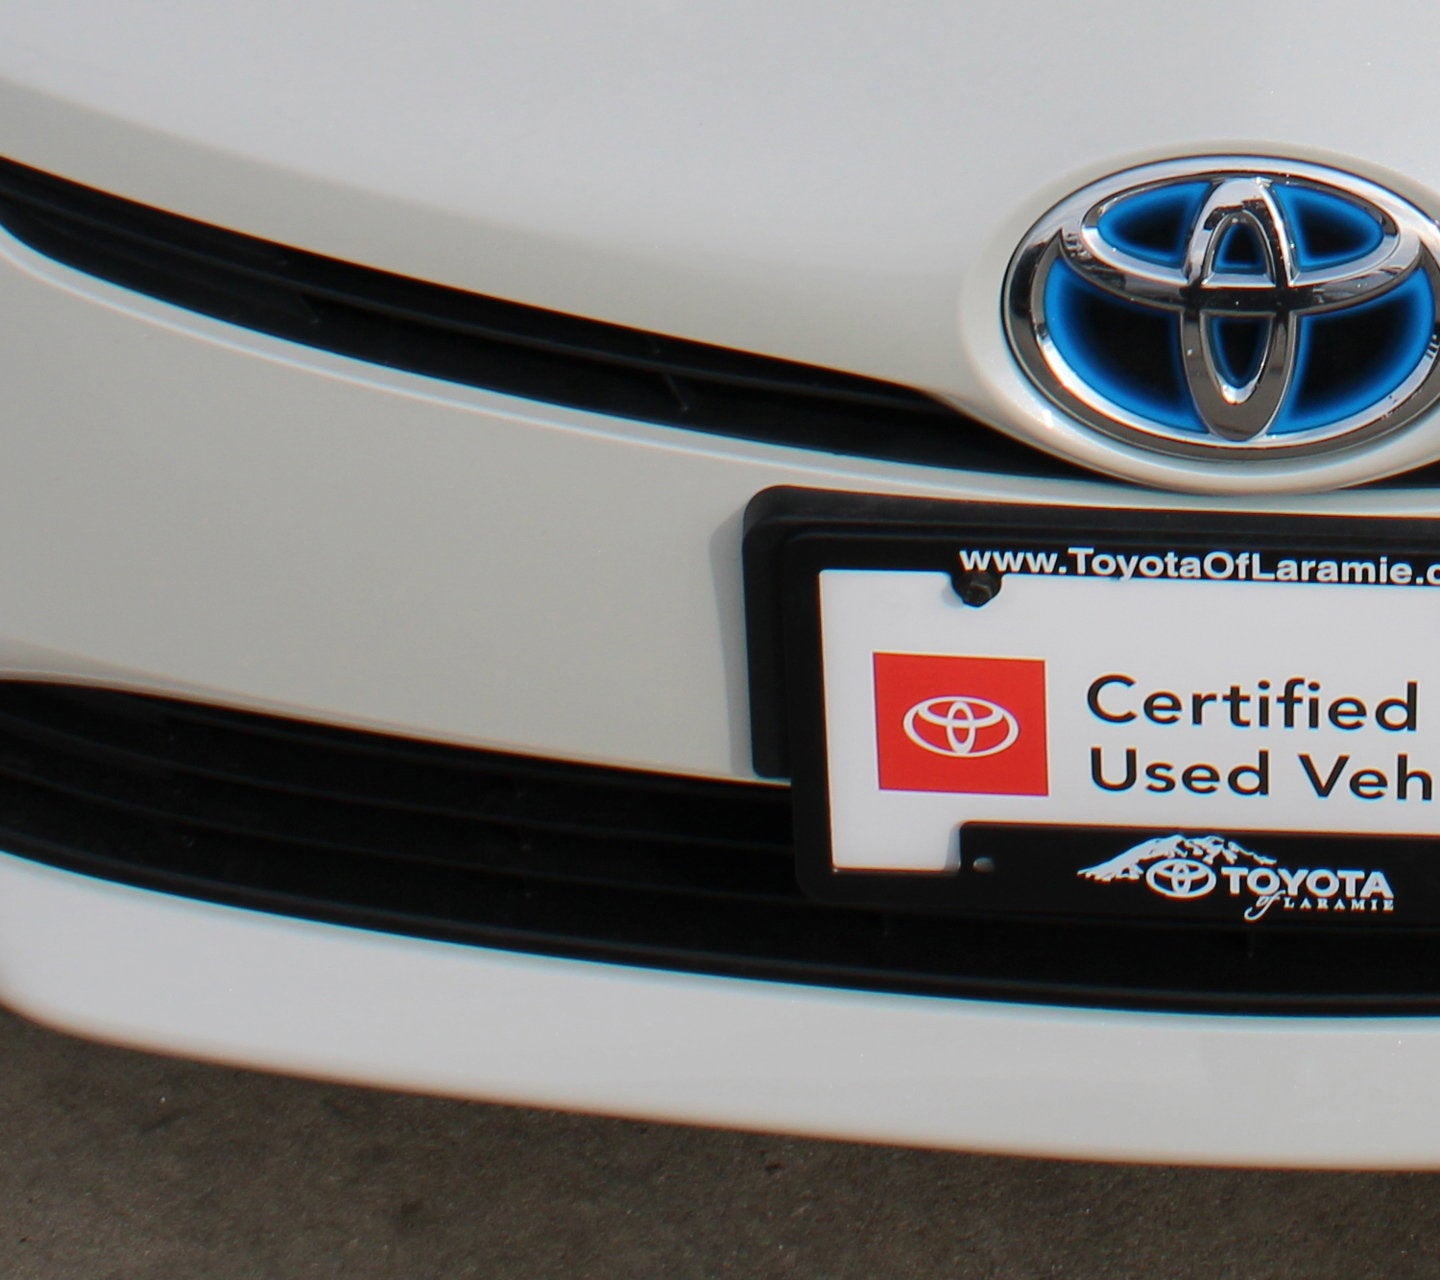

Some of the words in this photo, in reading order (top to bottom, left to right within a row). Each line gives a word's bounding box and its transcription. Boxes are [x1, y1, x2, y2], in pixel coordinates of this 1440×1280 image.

[1086, 673, 1418, 731] Certified
[1090, 746, 1270, 796] Used
[1220, 866, 1395, 899] TOYOTA
[1243, 889, 1287, 921] of
[1283, 896, 1395, 911] LARAMIE
